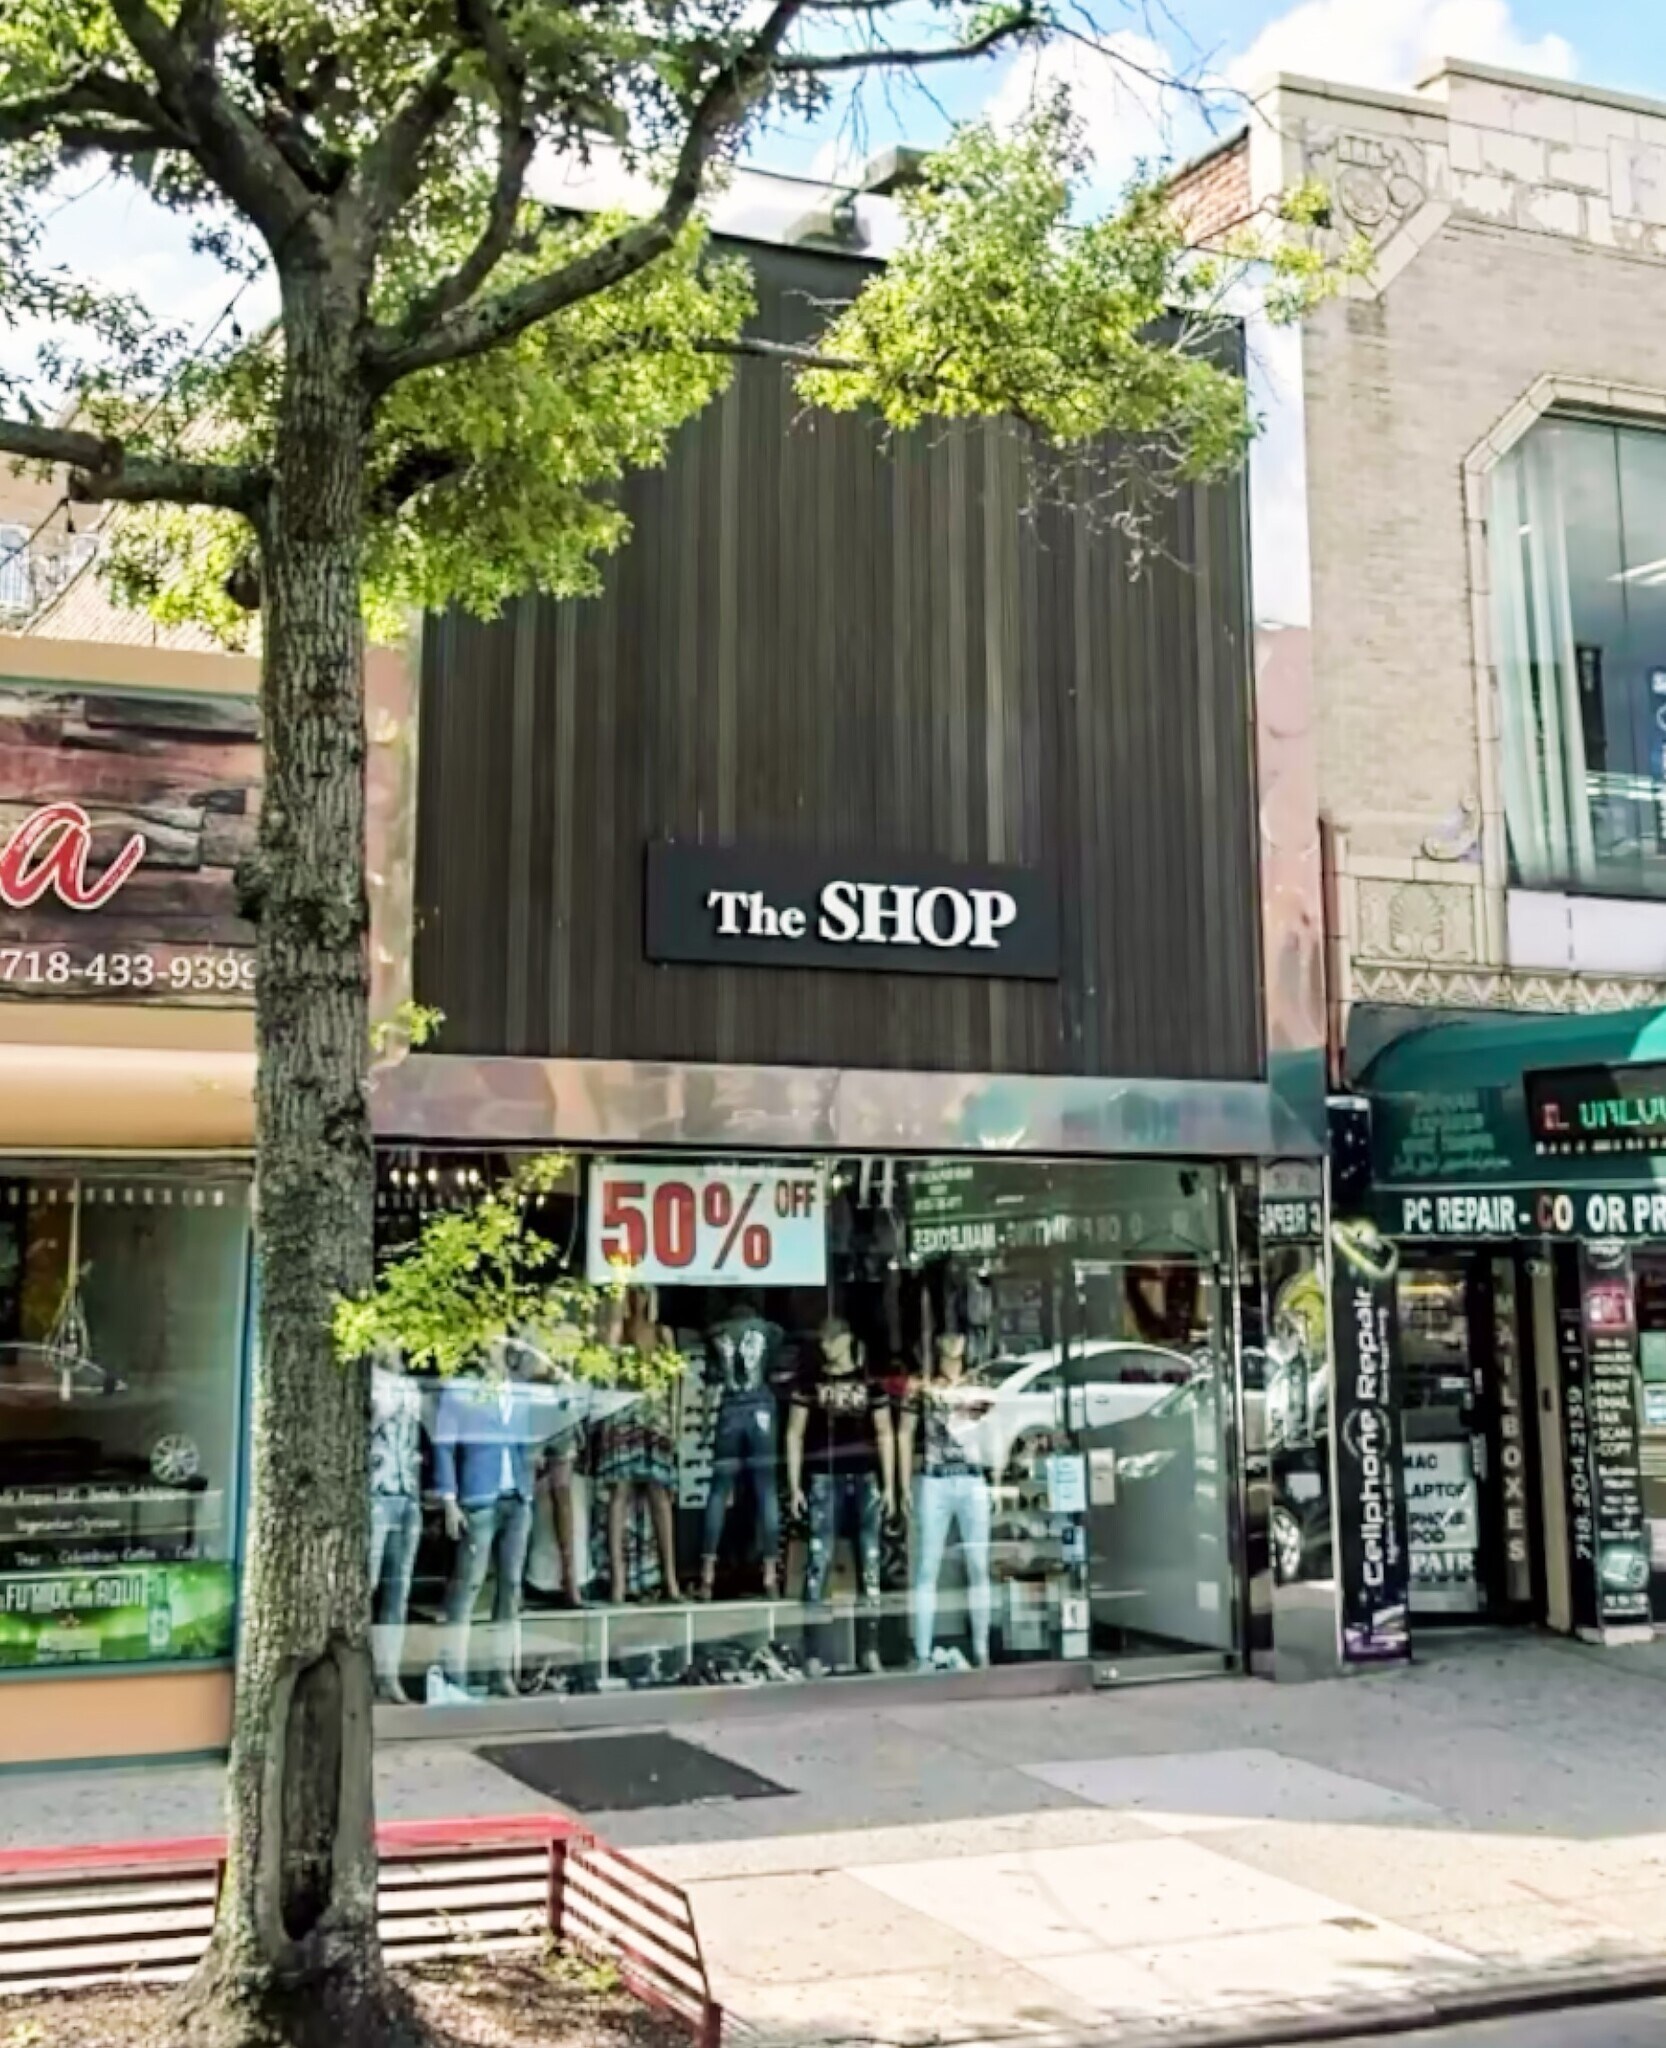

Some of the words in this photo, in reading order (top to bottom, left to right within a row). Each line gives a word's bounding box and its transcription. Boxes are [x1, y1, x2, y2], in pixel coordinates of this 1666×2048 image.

[707, 890, 807, 938] The
[818, 880, 1017, 949] SHOP
[600, 1179, 772, 1269] 50%
[774, 1179, 816, 1218] OFF
[1402, 1198, 1432, 1233] PC
[1435, 1196, 1517, 1233] REPAIR
[1353, 1287, 1379, 1400] Repair
[1493, 1292, 1526, 1562] MAILBOXES
[1357, 1405, 1386, 1587] Cellphone
